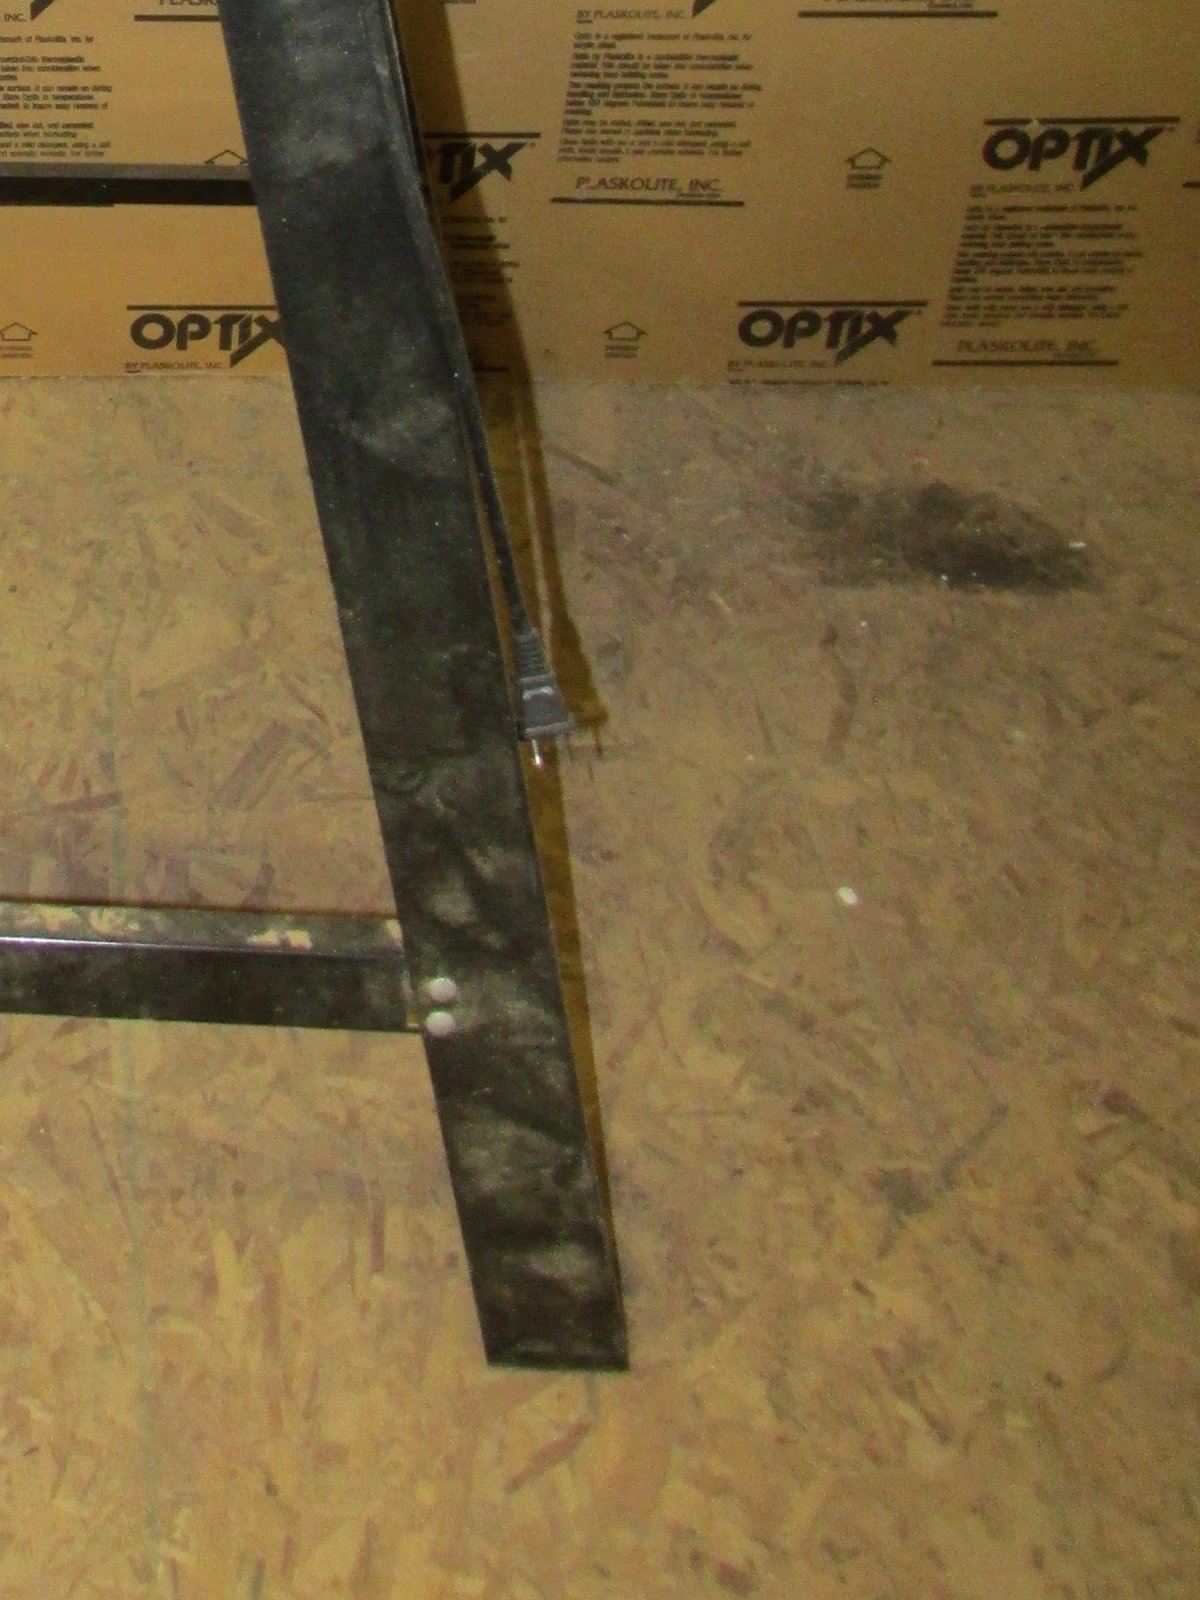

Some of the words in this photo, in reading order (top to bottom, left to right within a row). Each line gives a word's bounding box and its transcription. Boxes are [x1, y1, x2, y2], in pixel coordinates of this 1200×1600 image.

[4, 13, 27, 23] INC.
[982, 127, 1167, 192] OPTIX
[689, 178, 723, 192] INC.
[737, 309, 912, 366] OPTIX
